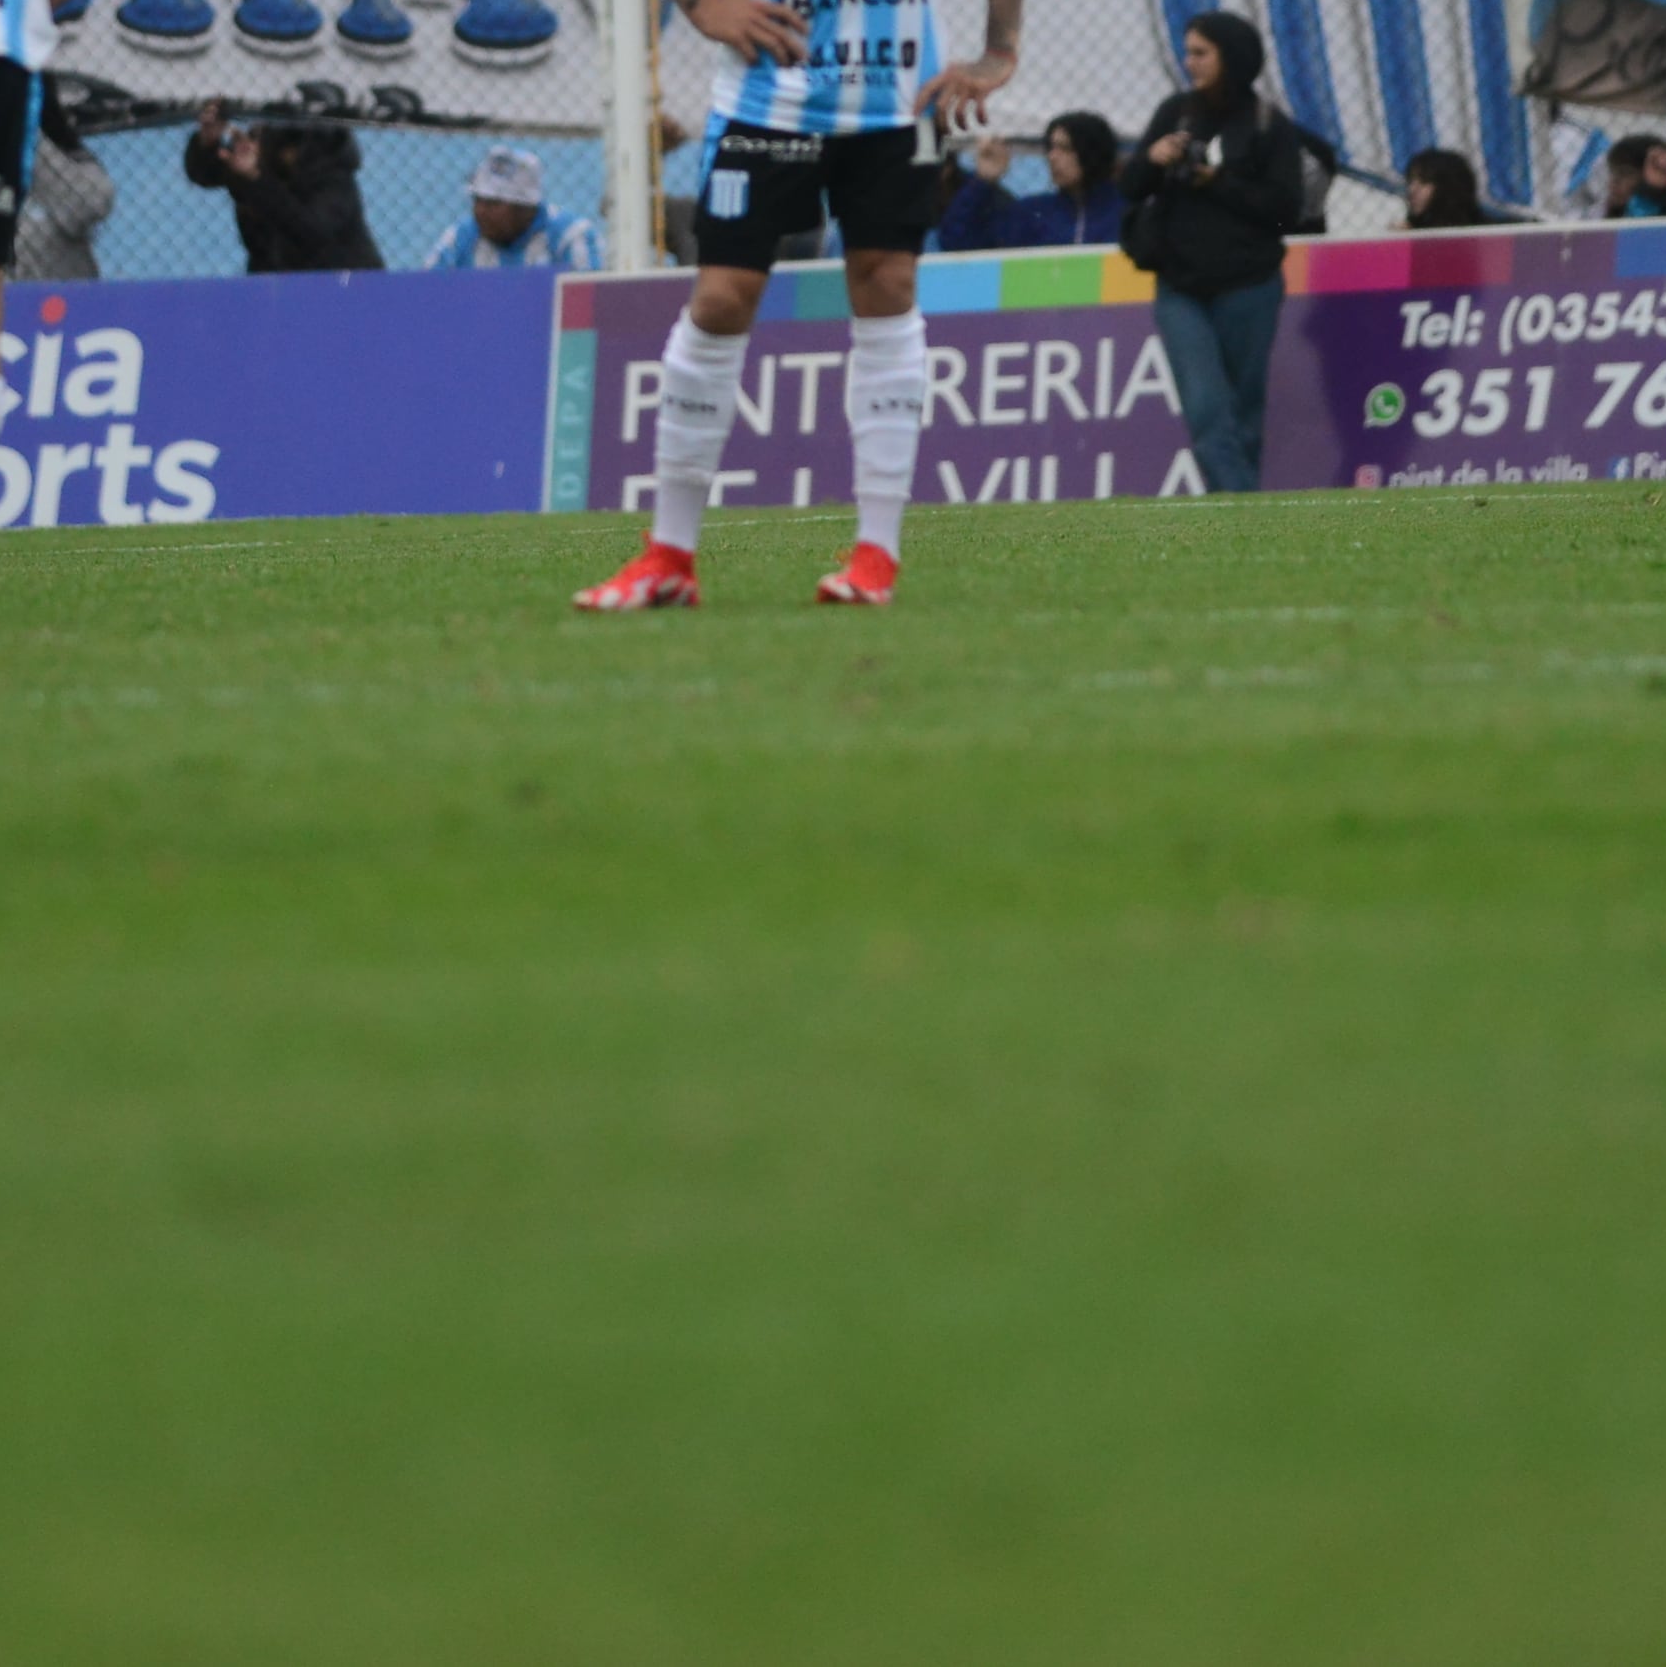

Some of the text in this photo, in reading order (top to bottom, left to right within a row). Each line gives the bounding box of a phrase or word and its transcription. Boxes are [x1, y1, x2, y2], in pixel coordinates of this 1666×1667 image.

[1400, 295, 1485, 349] Tel:
[622, 336, 1183, 441] PNTRERIA
[1412, 366, 1555, 438] 351
